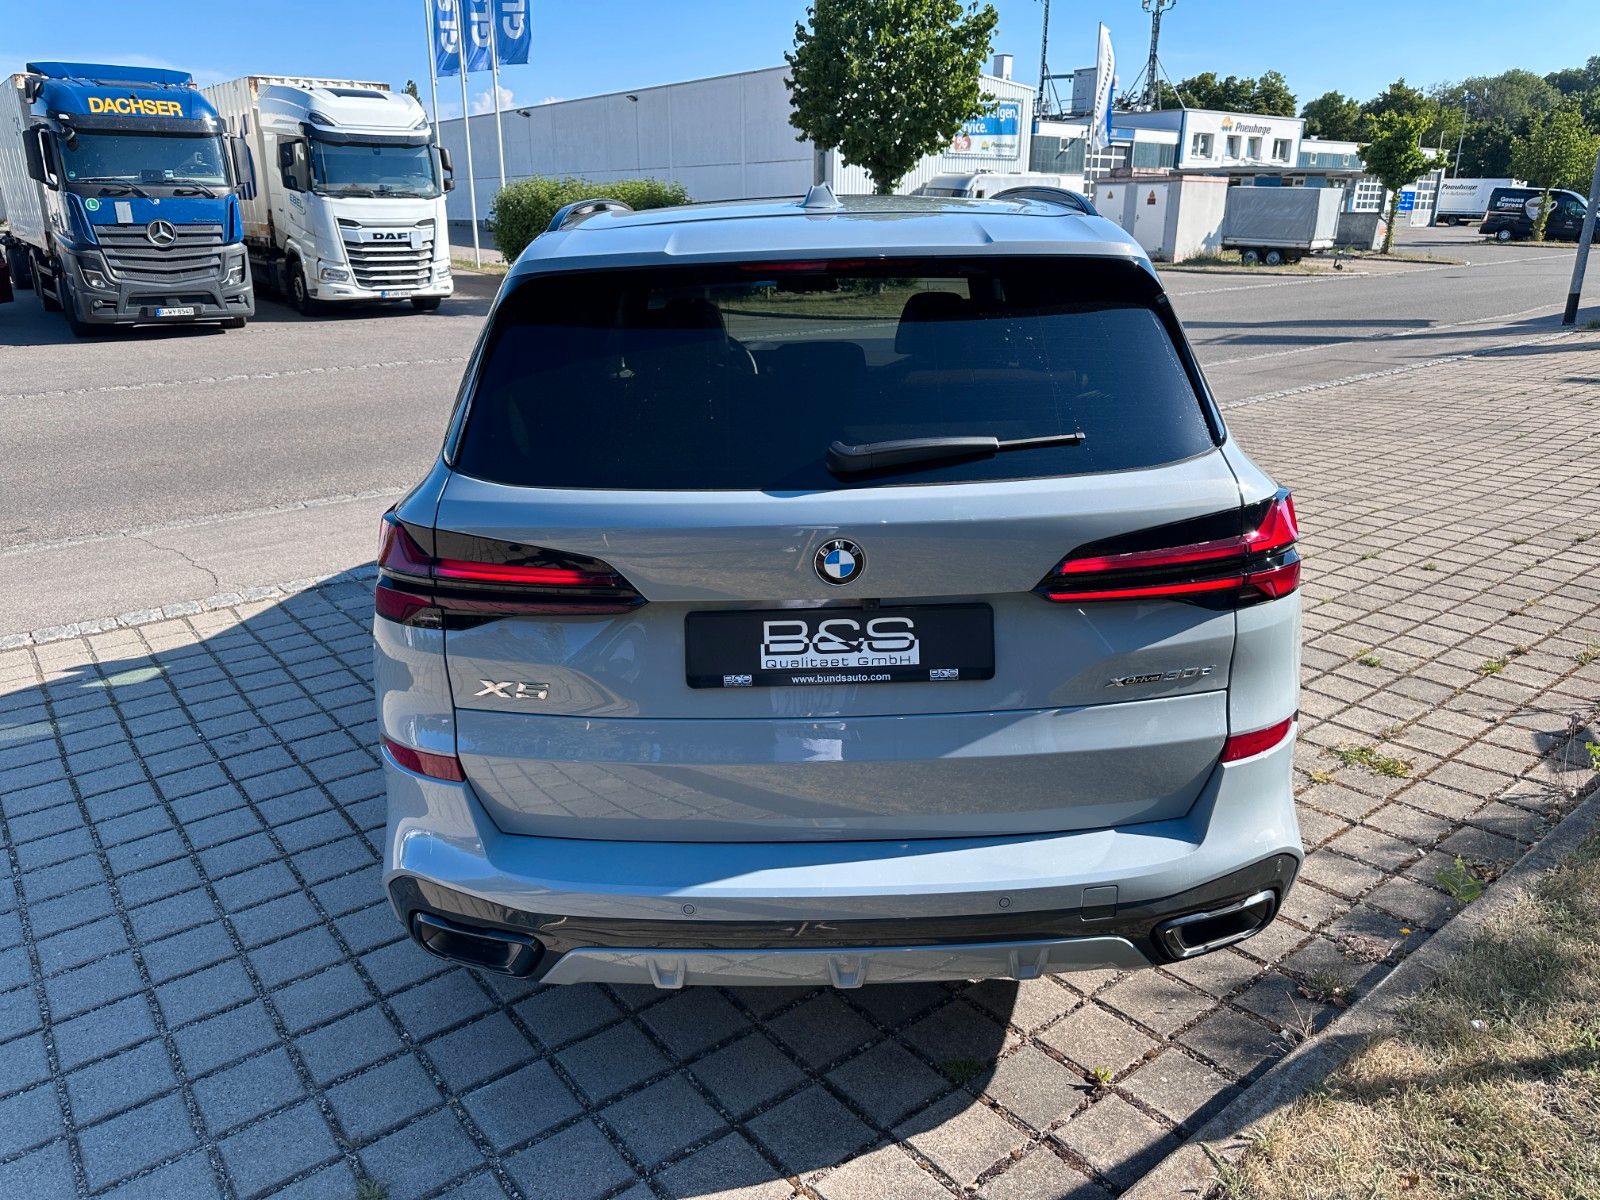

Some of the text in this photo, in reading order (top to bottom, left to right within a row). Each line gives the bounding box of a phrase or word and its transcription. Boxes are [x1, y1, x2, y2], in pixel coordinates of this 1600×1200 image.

[470, 0, 491, 48] GL
[88, 97, 184, 117] DACHSER
[962, 119, 988, 133] rvice.
[1235, 121, 1271, 135] Pneuhage
[372, 232, 408, 240] DAF
[820, 541, 860, 557] BMW
[763, 616, 916, 656] B&S
[765, 656, 849, 669] Qualitaet
[791, 673, 891, 684] www.bundsauto.com
[473, 679, 550, 700] X5
